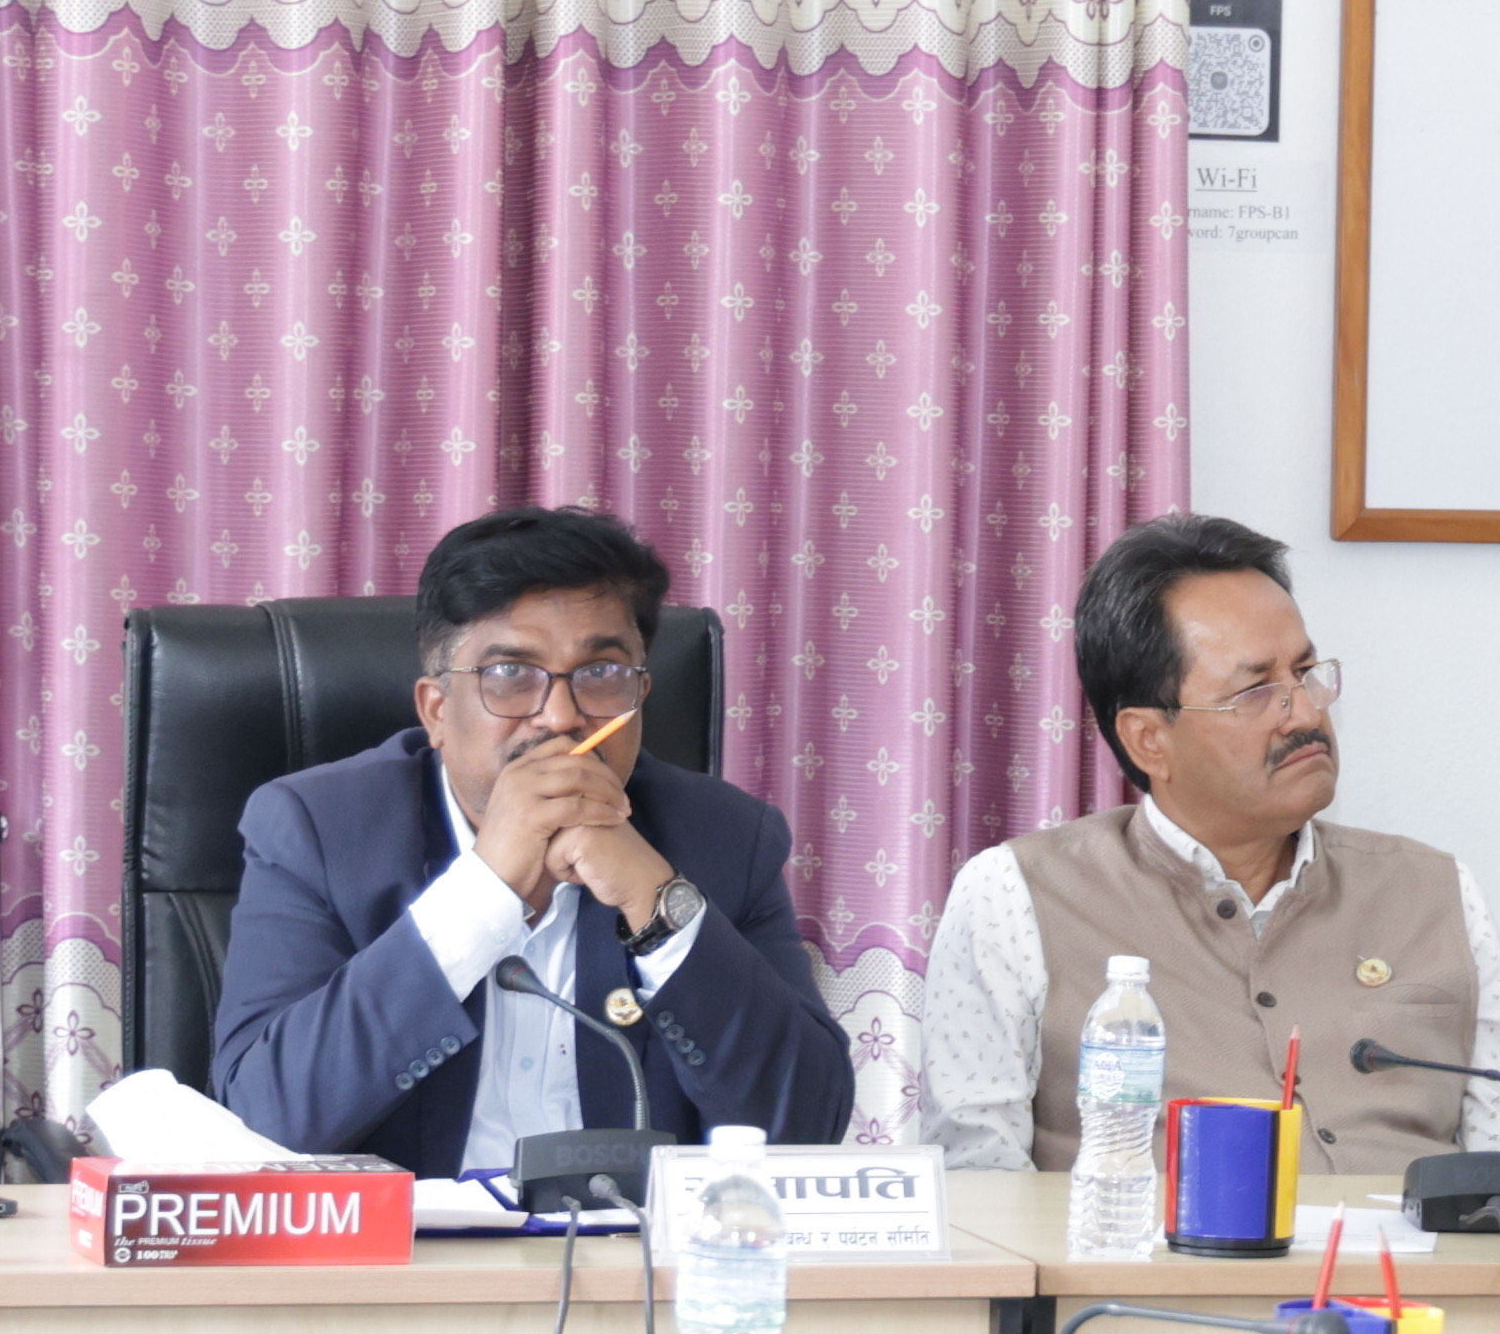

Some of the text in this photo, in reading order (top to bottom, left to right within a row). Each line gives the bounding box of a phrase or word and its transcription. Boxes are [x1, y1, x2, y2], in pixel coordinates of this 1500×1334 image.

[1210, 4, 1232, 17] FPS
[1196, 167, 1258, 190] Wi-Fi
[1188, 206, 1290, 221] rname: FPS-B1
[1228, 225, 1298, 244] 7groupcan
[115, 1192, 360, 1237] PREMIUM
[114, 1237, 137, 1247] the
[181, 1236, 219, 1246] tissue
[820, 1231, 832, 1247] र
[838, 1226, 879, 1247] पर्यटन
[887, 1225, 931, 1247] समिति
